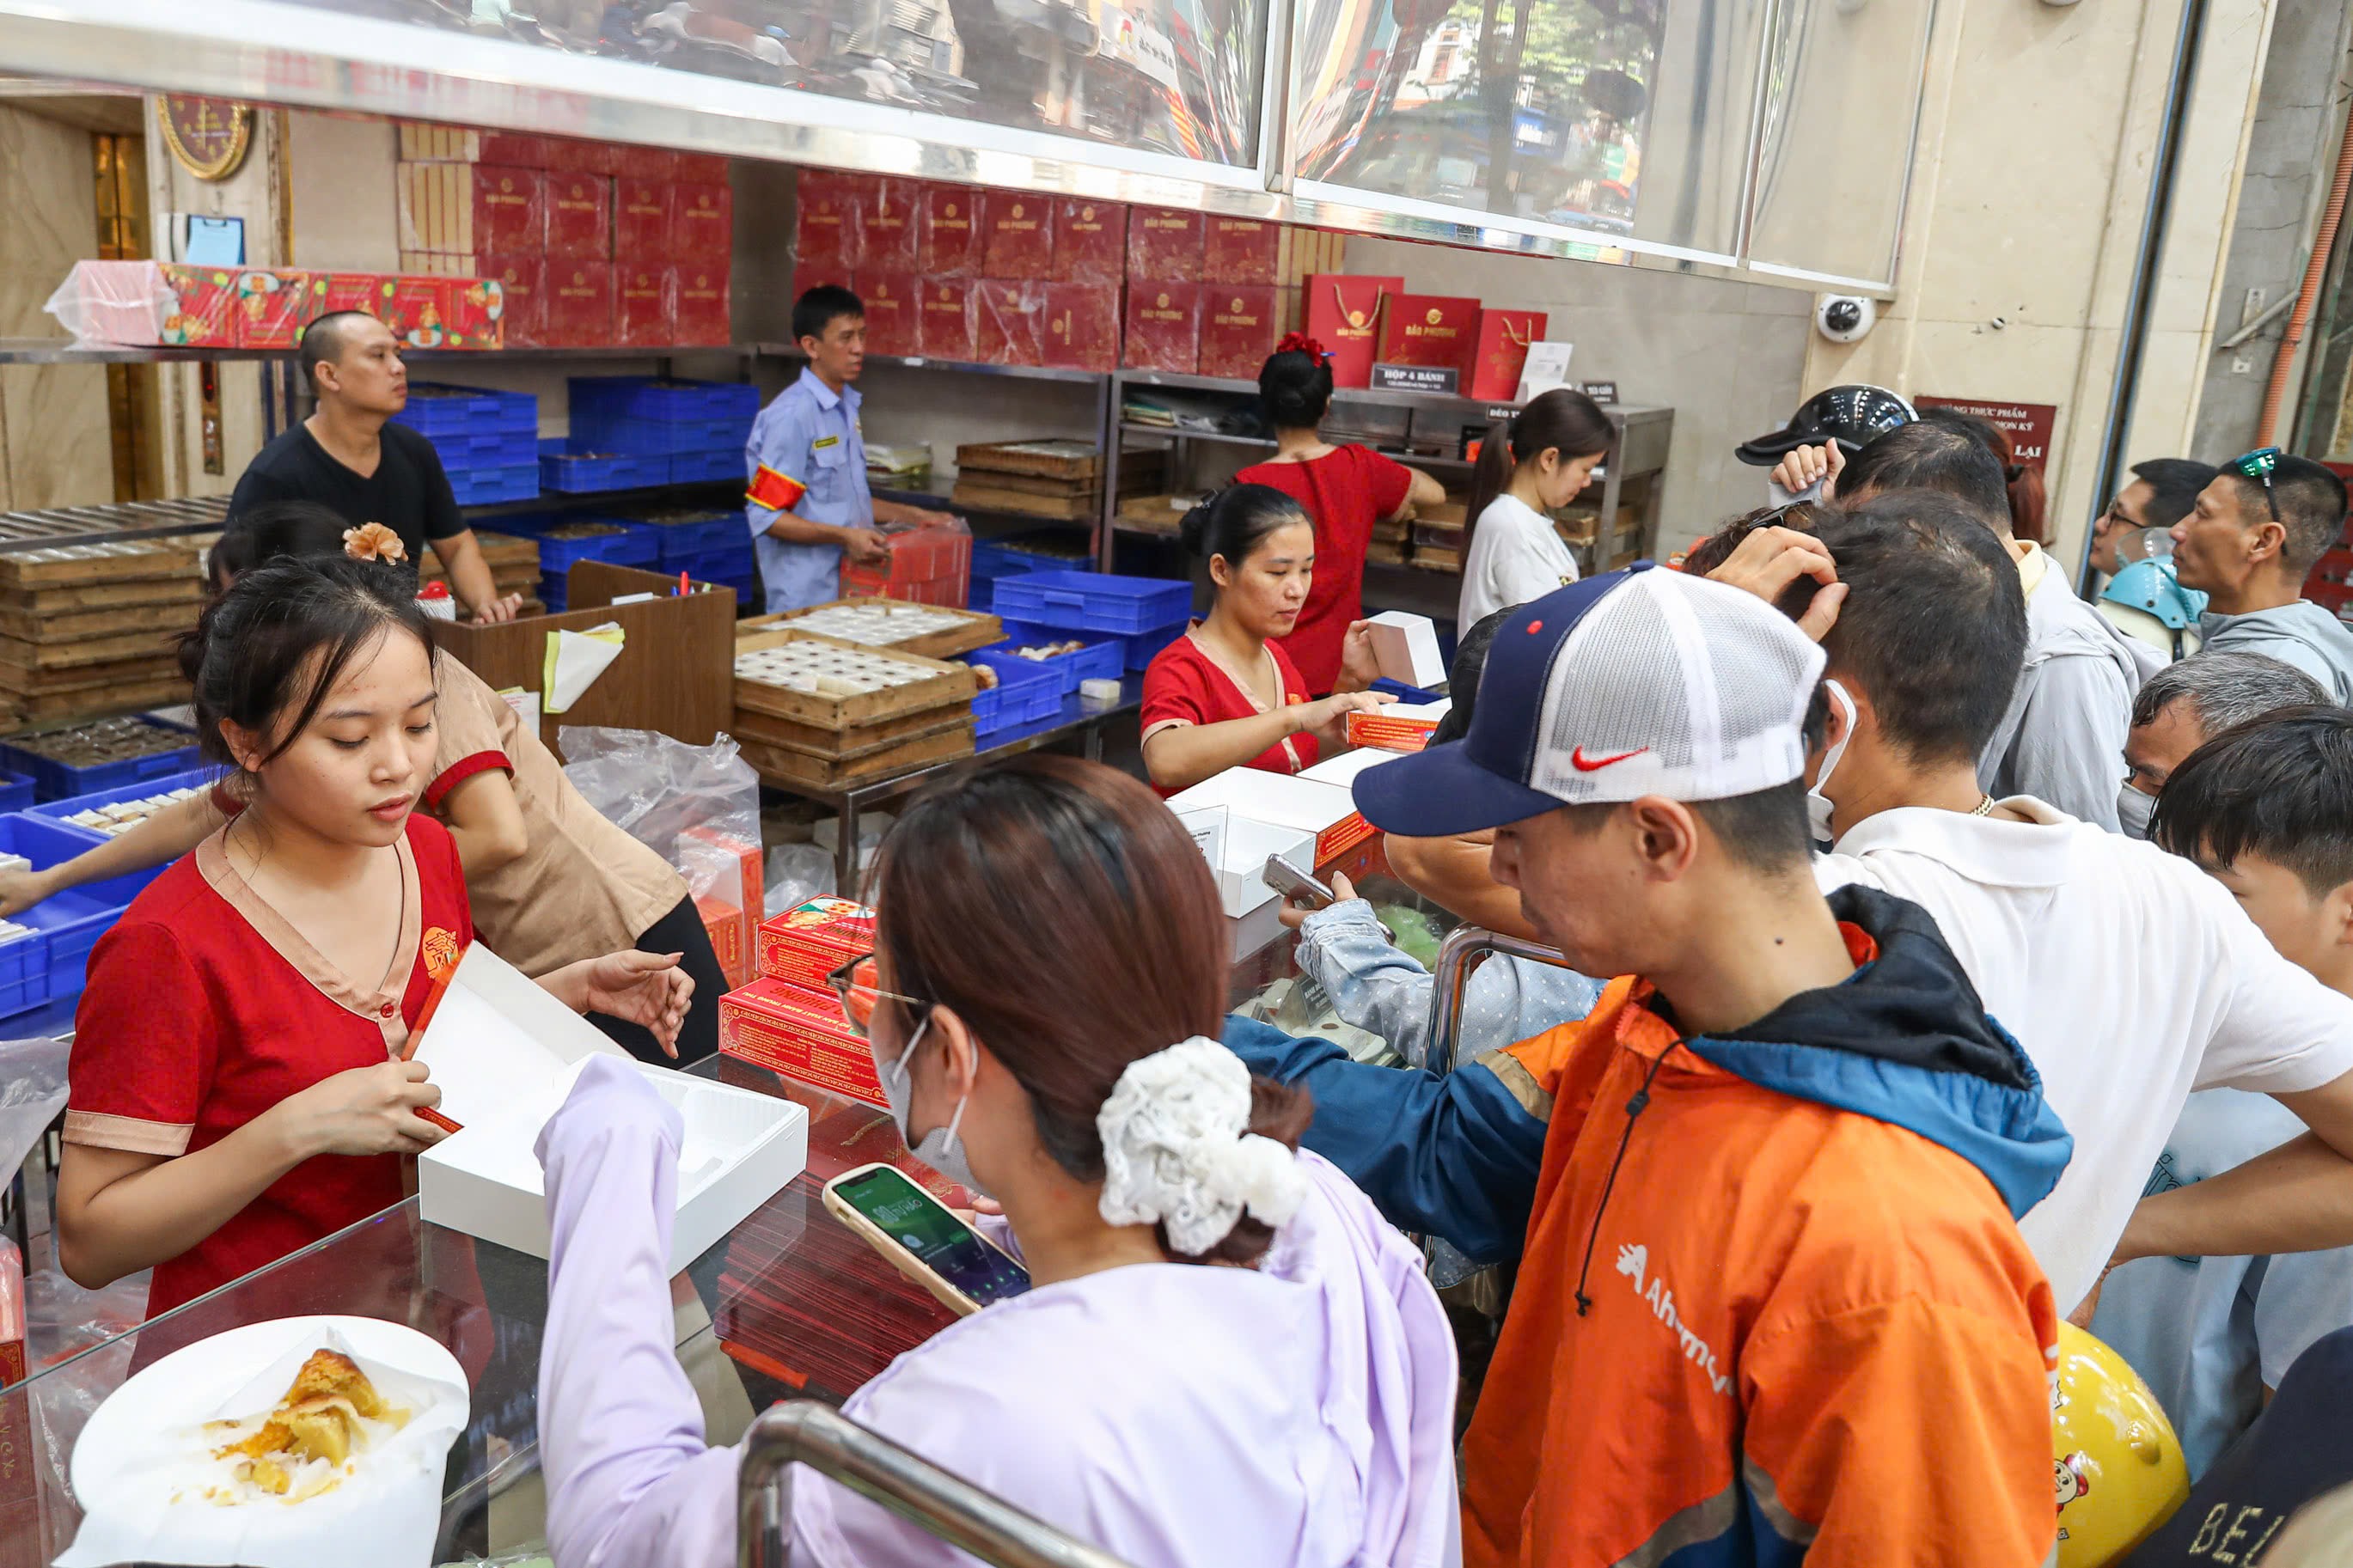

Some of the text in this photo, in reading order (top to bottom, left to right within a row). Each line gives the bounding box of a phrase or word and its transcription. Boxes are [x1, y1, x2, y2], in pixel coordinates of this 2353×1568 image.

[1408, 371, 1415, 381] 4
[2014, 444, 2042, 460] LẠI
[743, 991, 757, 999] THU
[757, 996, 780, 1007] TRUNG
